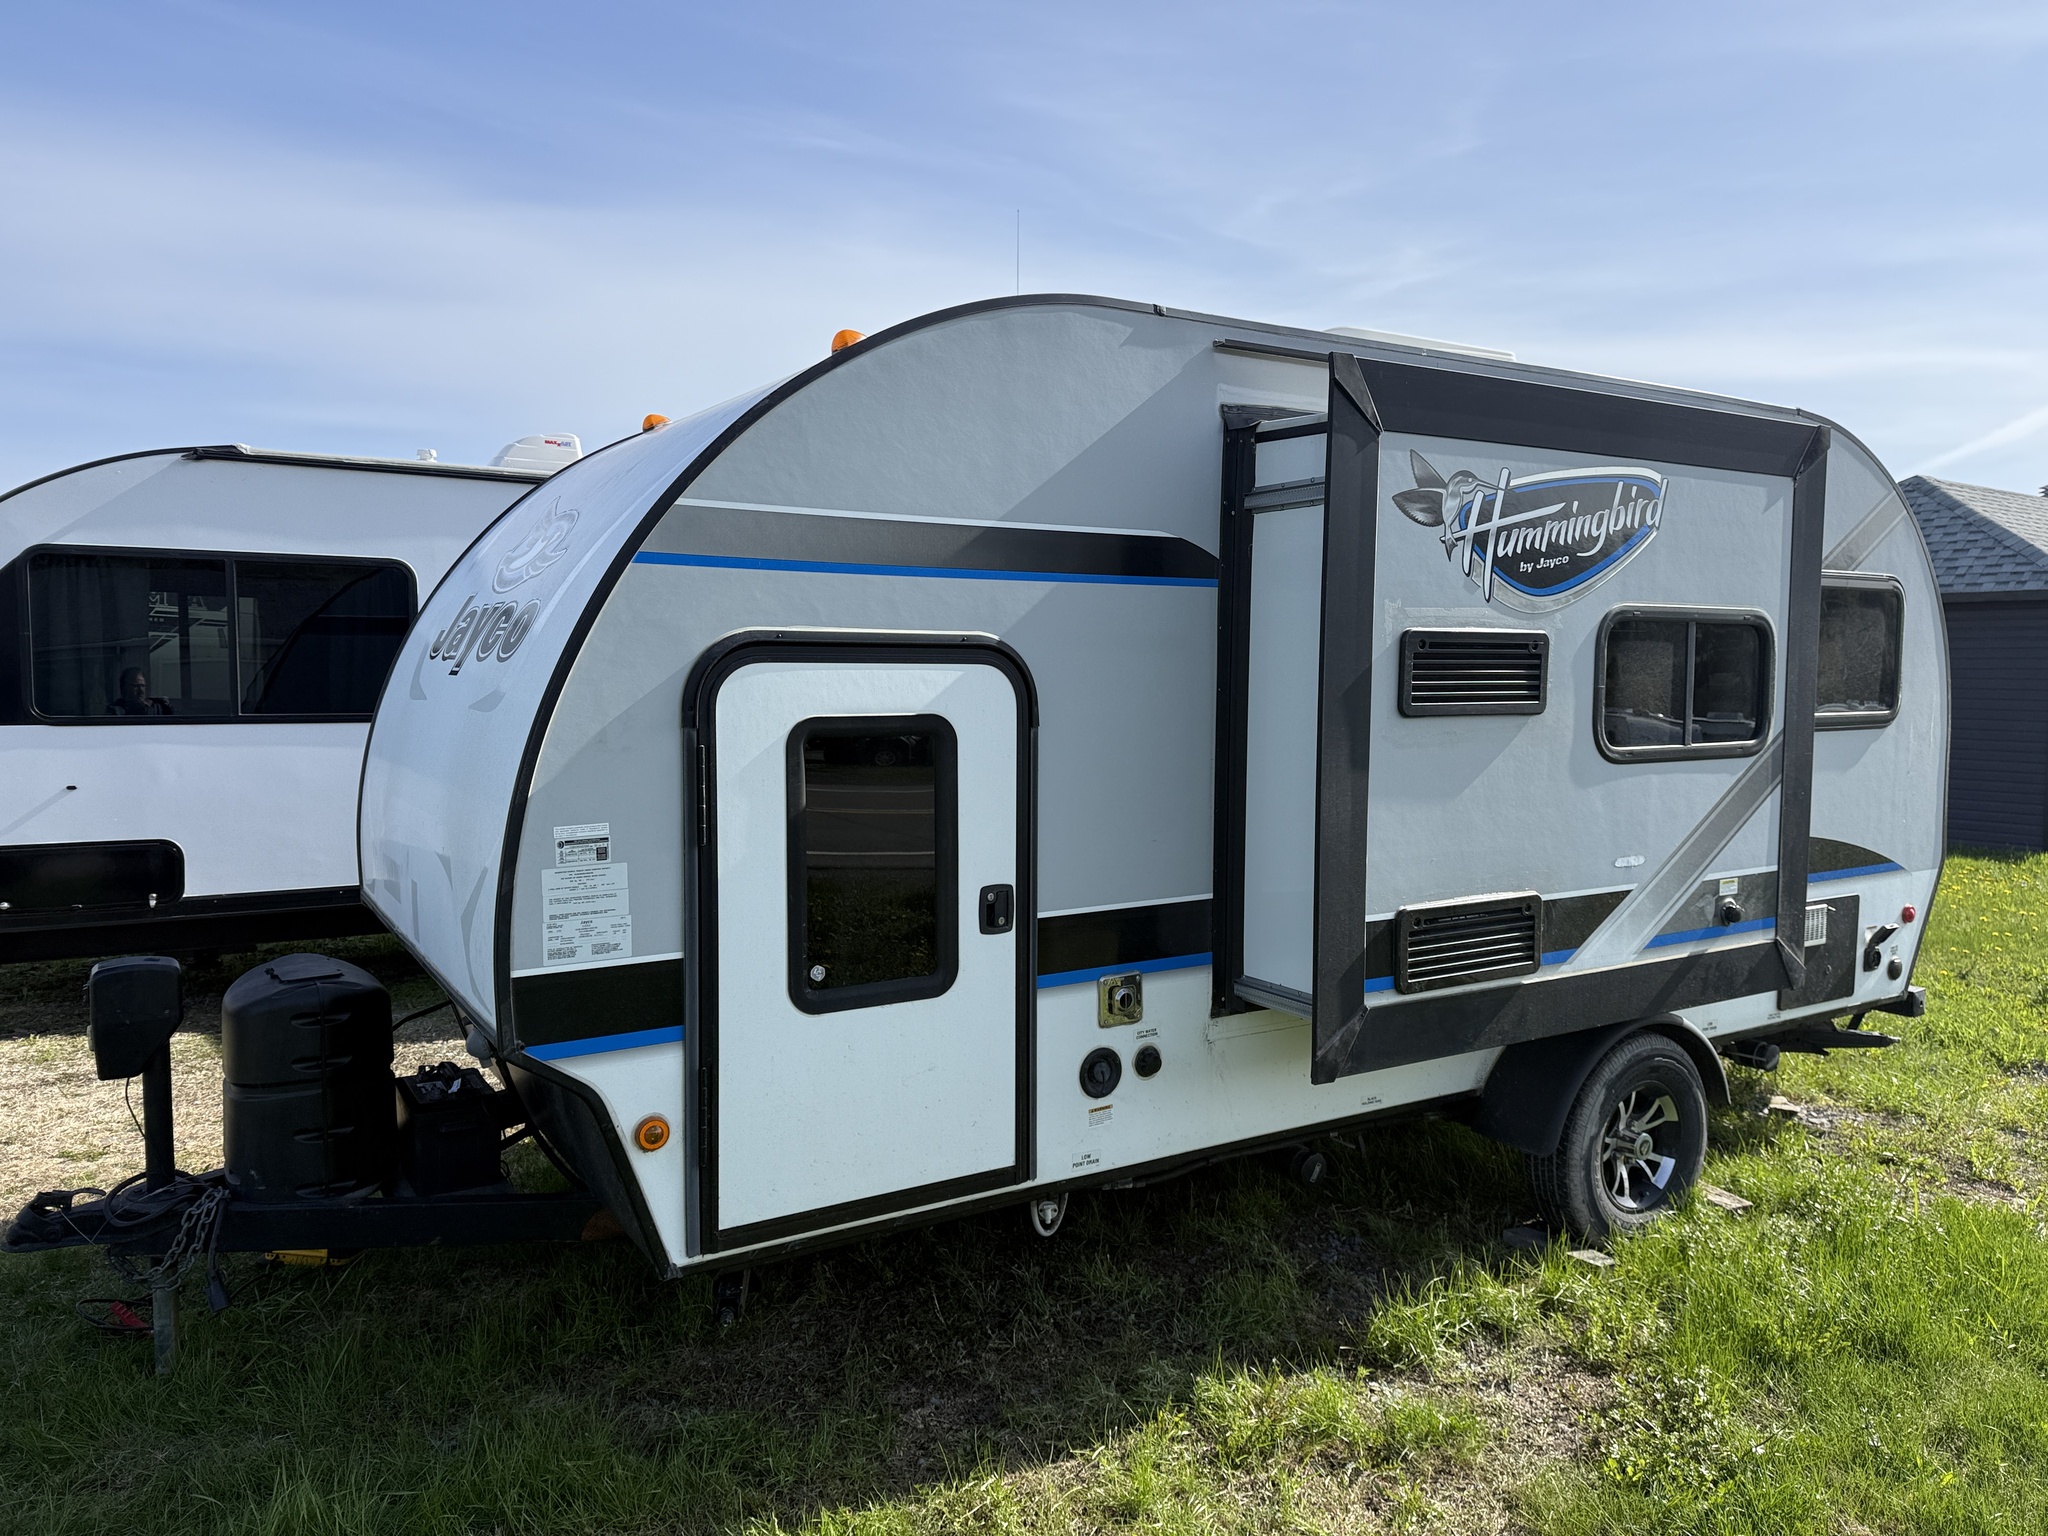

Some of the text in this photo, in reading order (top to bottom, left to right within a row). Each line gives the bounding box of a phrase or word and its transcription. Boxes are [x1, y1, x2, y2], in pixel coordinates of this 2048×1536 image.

[1439, 467, 1669, 603] Hummingbird
[1519, 555, 1570, 573] by Jayco
[429, 591, 541, 676] Jayco
[1072, 1158, 1100, 1169] POINT DRAIN
[1081, 1153, 1092, 1161] LOW
